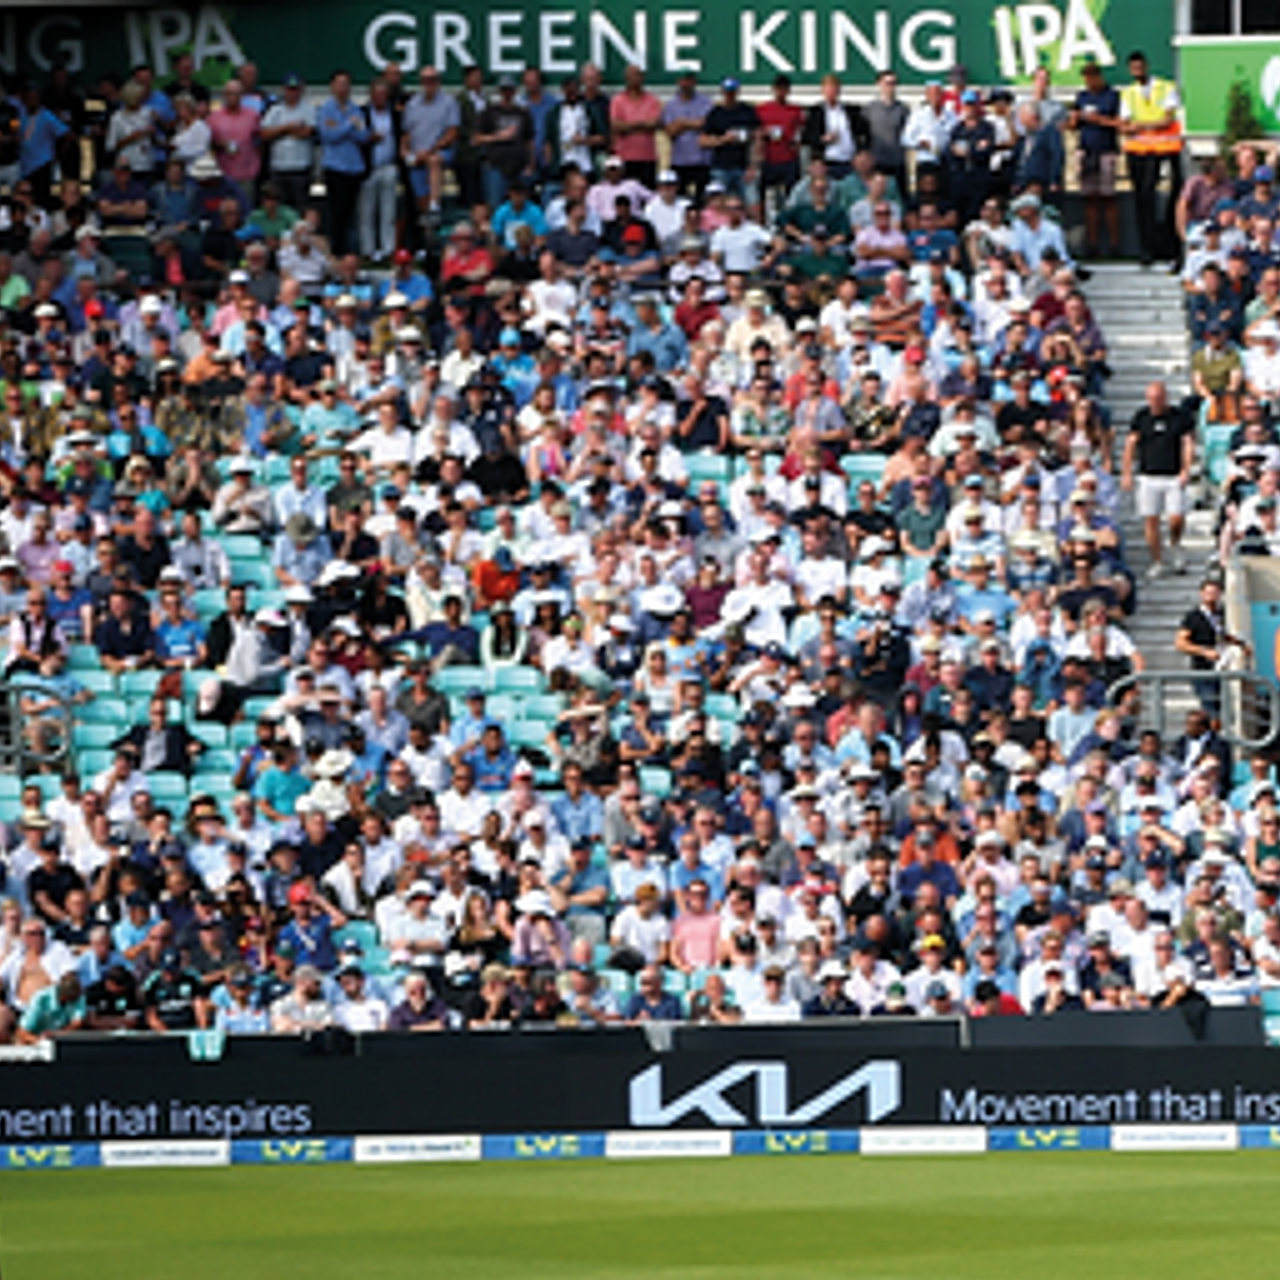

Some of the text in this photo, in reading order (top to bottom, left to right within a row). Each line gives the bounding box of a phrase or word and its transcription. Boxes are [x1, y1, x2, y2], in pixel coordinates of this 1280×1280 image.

[124, 7, 247, 77] IPA
[364, 0, 1115, 78] GREENE KING IPA
[85, 1099, 158, 1137] that
[169, 1099, 313, 1140] inspires
[940, 1087, 1139, 1122] Movement
[1148, 1085, 1223, 1121] that
